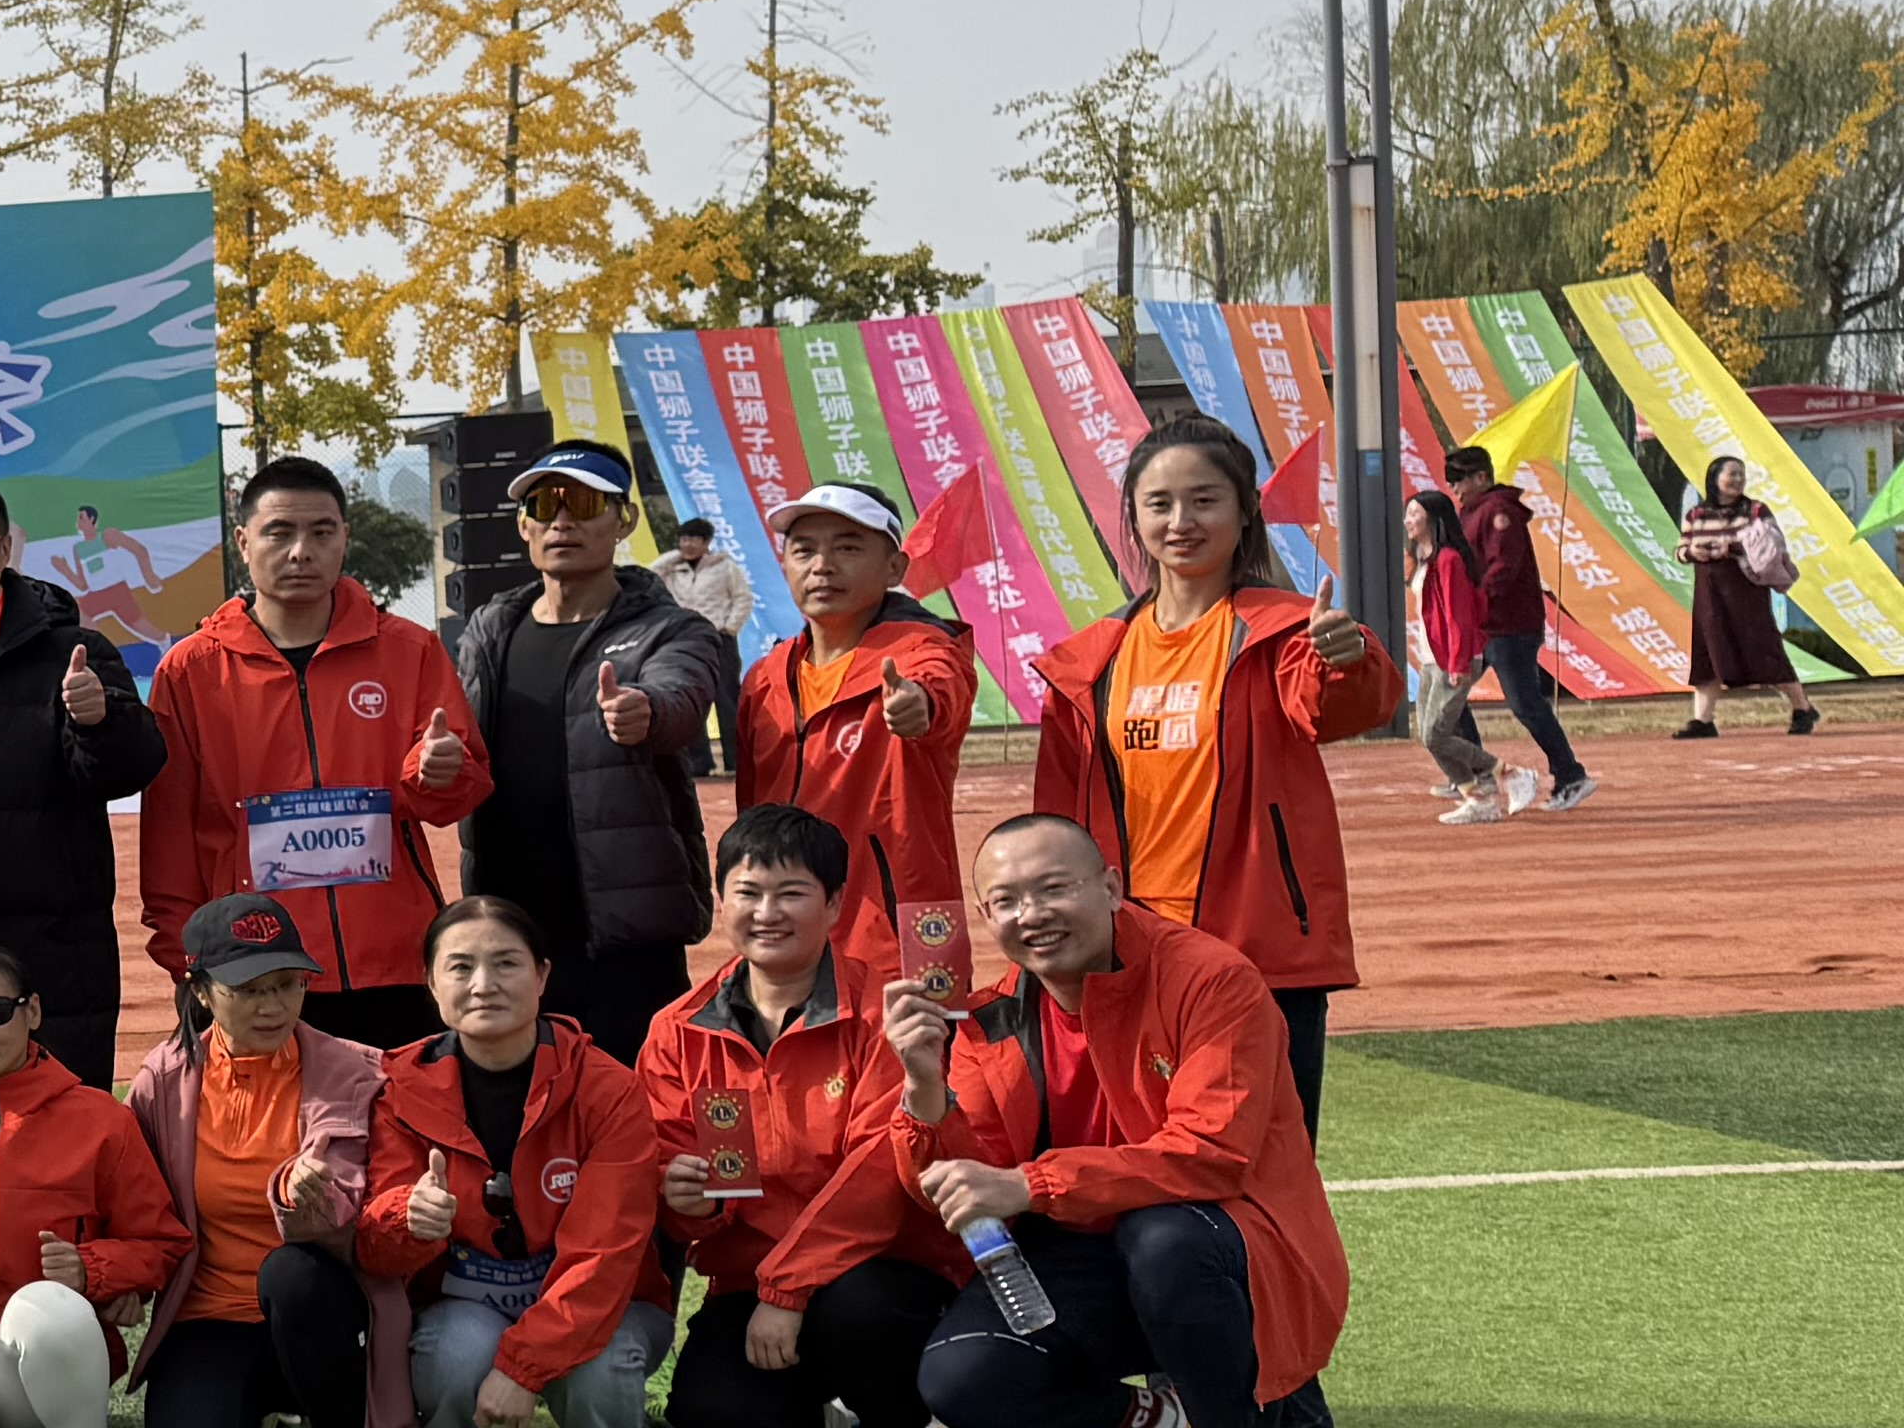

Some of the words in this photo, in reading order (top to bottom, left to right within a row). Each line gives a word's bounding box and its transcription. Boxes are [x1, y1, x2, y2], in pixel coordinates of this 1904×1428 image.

[805, 337, 876, 486] 中国狮子联
[1127, 681, 1202, 716] 黑暗
[282, 826, 366, 853] A0005
